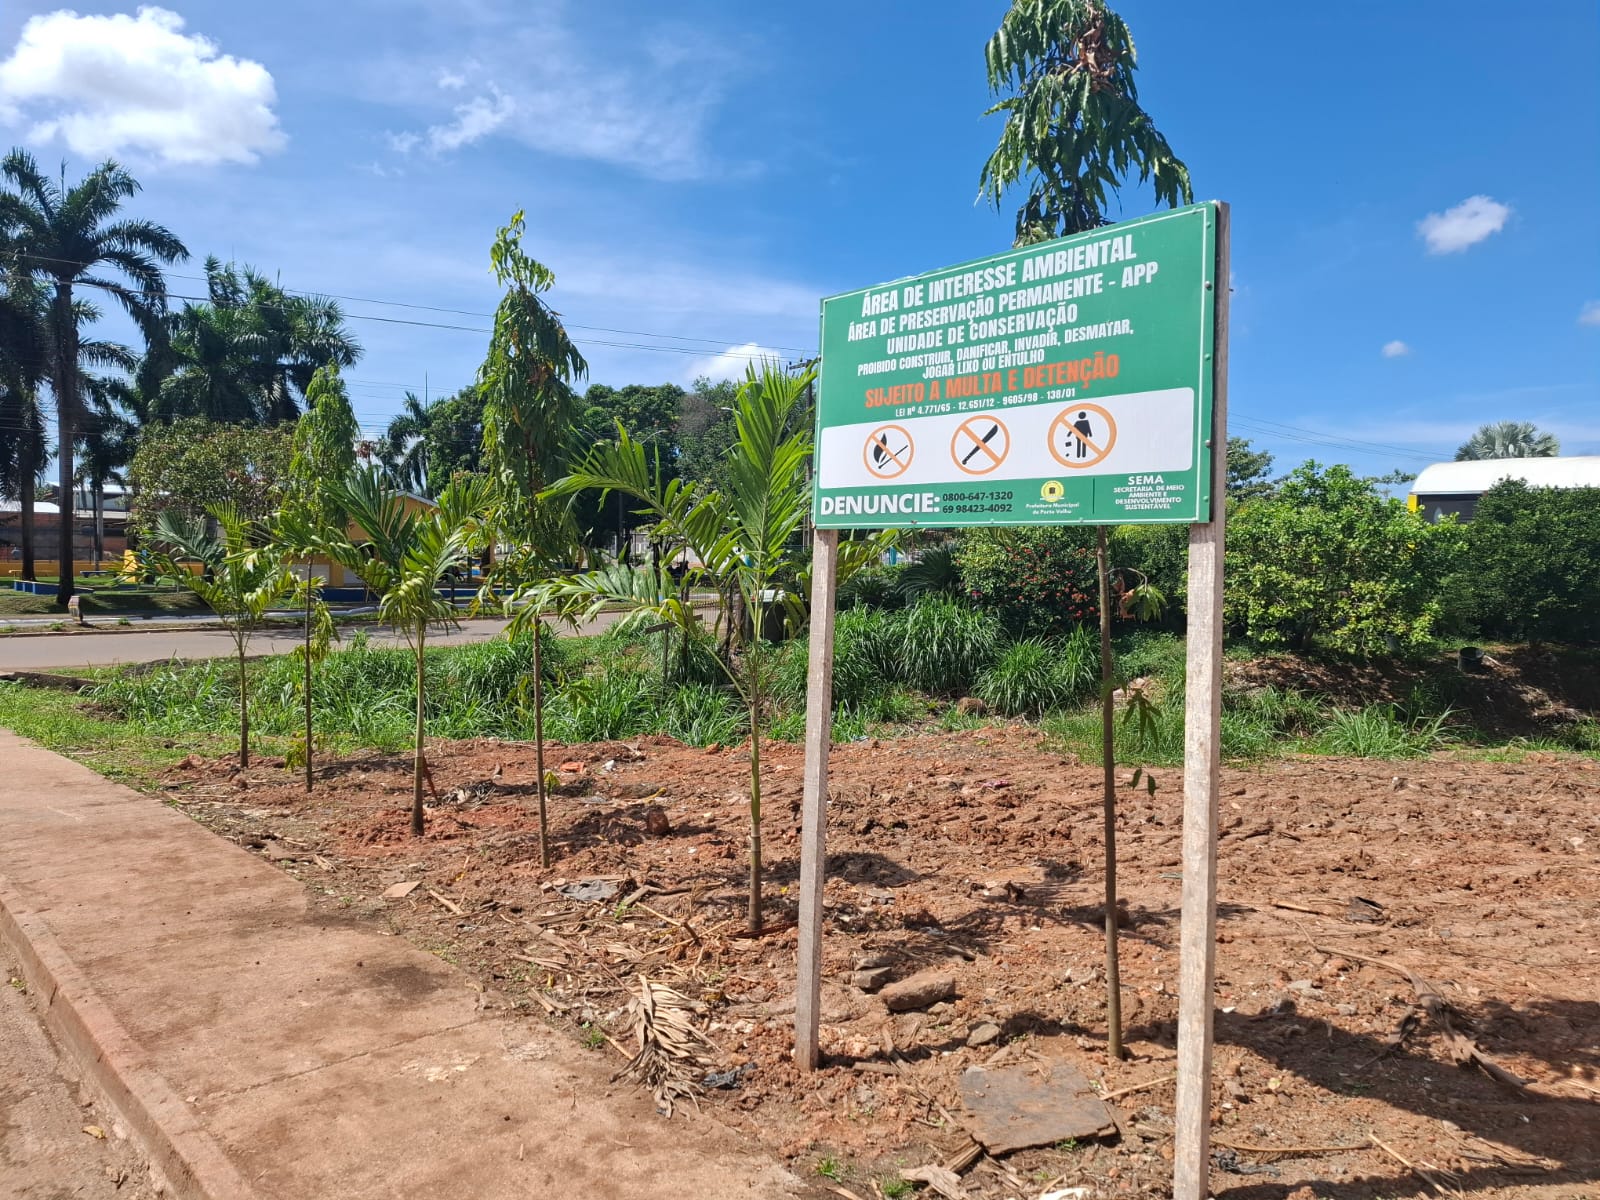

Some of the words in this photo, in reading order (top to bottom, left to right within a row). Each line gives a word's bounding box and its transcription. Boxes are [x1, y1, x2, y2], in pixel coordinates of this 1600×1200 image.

[862, 291, 898, 317] ÁREA
[904, 284, 923, 308] DE
[929, 262, 1016, 304] INTERESSE
[1022, 234, 1136, 283] AMBIENTAL
[848, 321, 876, 342] ÁREA
[880, 316, 896, 335] DE
[899, 294, 994, 332] PRESERVAÇÃO
[999, 273, 1103, 313] PERMANENTE
[1121, 261, 1158, 288] APP
[887, 330, 943, 354] UNIDADE
[948, 325, 965, 345] DE
[969, 301, 1078, 341] CONSERVAÇÃO
[858, 359, 897, 376] PROIBIDO
[900, 350, 954, 370] CONSTRUIR,
[957, 340, 1011, 361] DANIFICAR,
[1015, 332, 1061, 352] INVADIR,
[1064, 319, 1134, 344] DESMATAR,
[922, 363, 955, 379] JOGAR
[958, 358, 979, 375] LIXO
[982, 357, 996, 371] OU
[998, 349, 1045, 369] ENTULHO
[865, 382, 925, 408] SUJEITO
[930, 380, 940, 401] A
[945, 372, 1002, 399] MULTA
[1008, 369, 1018, 392] E
[1024, 351, 1120, 389] DETENÇÃO
[895, 408, 906, 417] LEI
[1128, 475, 1164, 485] SEMA
[821, 493, 940, 515] DENUNCIE:
[943, 491, 1013, 502] 0800-647-1320
[943, 505, 954, 514] 69
[956, 503, 1012, 514] 98423-4092
[1115, 497, 1182, 505] DESENVOLVIMENTO
